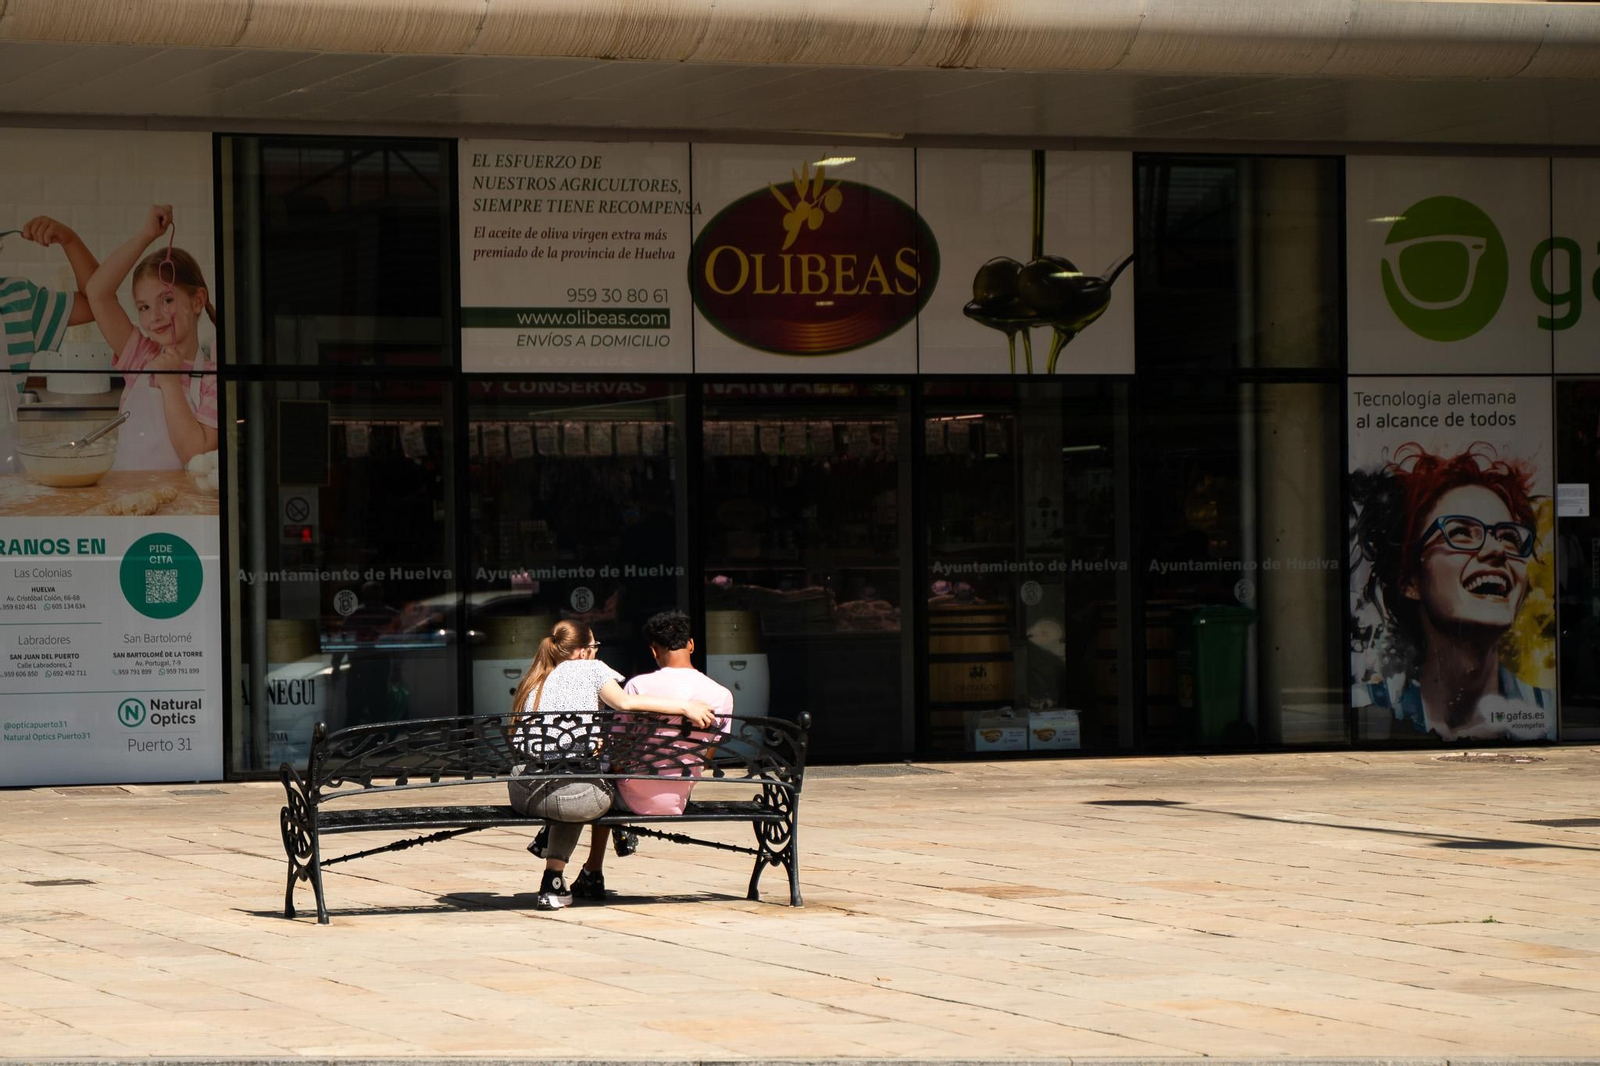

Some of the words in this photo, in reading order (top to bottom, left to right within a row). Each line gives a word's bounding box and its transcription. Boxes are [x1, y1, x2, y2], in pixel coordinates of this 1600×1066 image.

[472, 153, 490, 168] EL
[494, 154, 577, 168] ESFUERZO
[580, 155, 602, 169] DE
[472, 176, 557, 191] NUESTROS
[560, 177, 682, 194] AGRICULTORES,
[473, 198, 542, 213] SIEMPRE
[547, 199, 594, 214] TIENE
[599, 200, 702, 215] RECOMPENSA
[474, 226, 486, 239] El
[488, 227, 522, 240] aceite
[524, 227, 538, 240] de
[540, 227, 569, 240] oliva
[572, 228, 608, 244] virgen
[612, 229, 641, 240] extra
[644, 228, 668, 241] más
[473, 246, 528, 262] premiado
[530, 246, 544, 258] de
[547, 246, 558, 259] la
[560, 247, 616, 263] provincia
[618, 247, 632, 259] de
[634, 248, 676, 260] Huelva
[705, 245, 921, 296] OLIBEAS
[1530, 236, 1600, 332] g
[567, 288, 596, 303] 959
[602, 289, 622, 303] 30
[627, 289, 649, 303] 80
[653, 289, 668, 303] 61
[517, 310, 668, 326] www.olibeas.com
[517, 332, 572, 347] ENVÍOS
[575, 334, 586, 347] A
[590, 334, 670, 347] DOMICILIO
[503, 381, 647, 394] CONSERVAS
[1354, 390, 1441, 409] Tecnología
[1447, 391, 1516, 405] alemana
[1356, 414, 1370, 428] al
[1376, 413, 1439, 428] alcance
[1445, 412, 1464, 426] de
[1470, 411, 1516, 426] todos
[77, 538, 106, 554] EN
[149, 545, 173, 553] PIDE
[149, 555, 173, 564] CITA
[932, 560, 1044, 576] Ayuntamiento
[1048, 560, 1068, 572] de
[1071, 559, 1128, 572] Huelva
[1149, 558, 1258, 575] Ayuntamiento
[1262, 558, 1281, 570] de
[1287, 558, 1340, 570] Huelva
[14, 568, 30, 578] Las
[32, 568, 72, 578] Colonias
[237, 568, 360, 585] Ayuntamiento
[364, 568, 386, 581] de
[390, 567, 453, 580] Huelva
[476, 566, 595, 583] Ayuntamiento
[600, 565, 620, 578] de
[625, 564, 685, 578] Huelva
[18, 635, 71, 645] Labradores
[124, 633, 141, 644] San
[144, 632, 192, 643] Bartolomé
[242, 678, 316, 706] ANEGUI
[150, 698, 202, 710] Natural
[150, 712, 196, 727] Optics
[1506, 711, 1545, 722] gafas.es
[4, 721, 67, 730] @opticapuerto31
[4, 733, 31, 742] Natural
[32, 732, 56, 742] Optics
[57, 732, 91, 741] Puerto31
[128, 739, 173, 752] Puerto
[177, 738, 192, 751] 31
